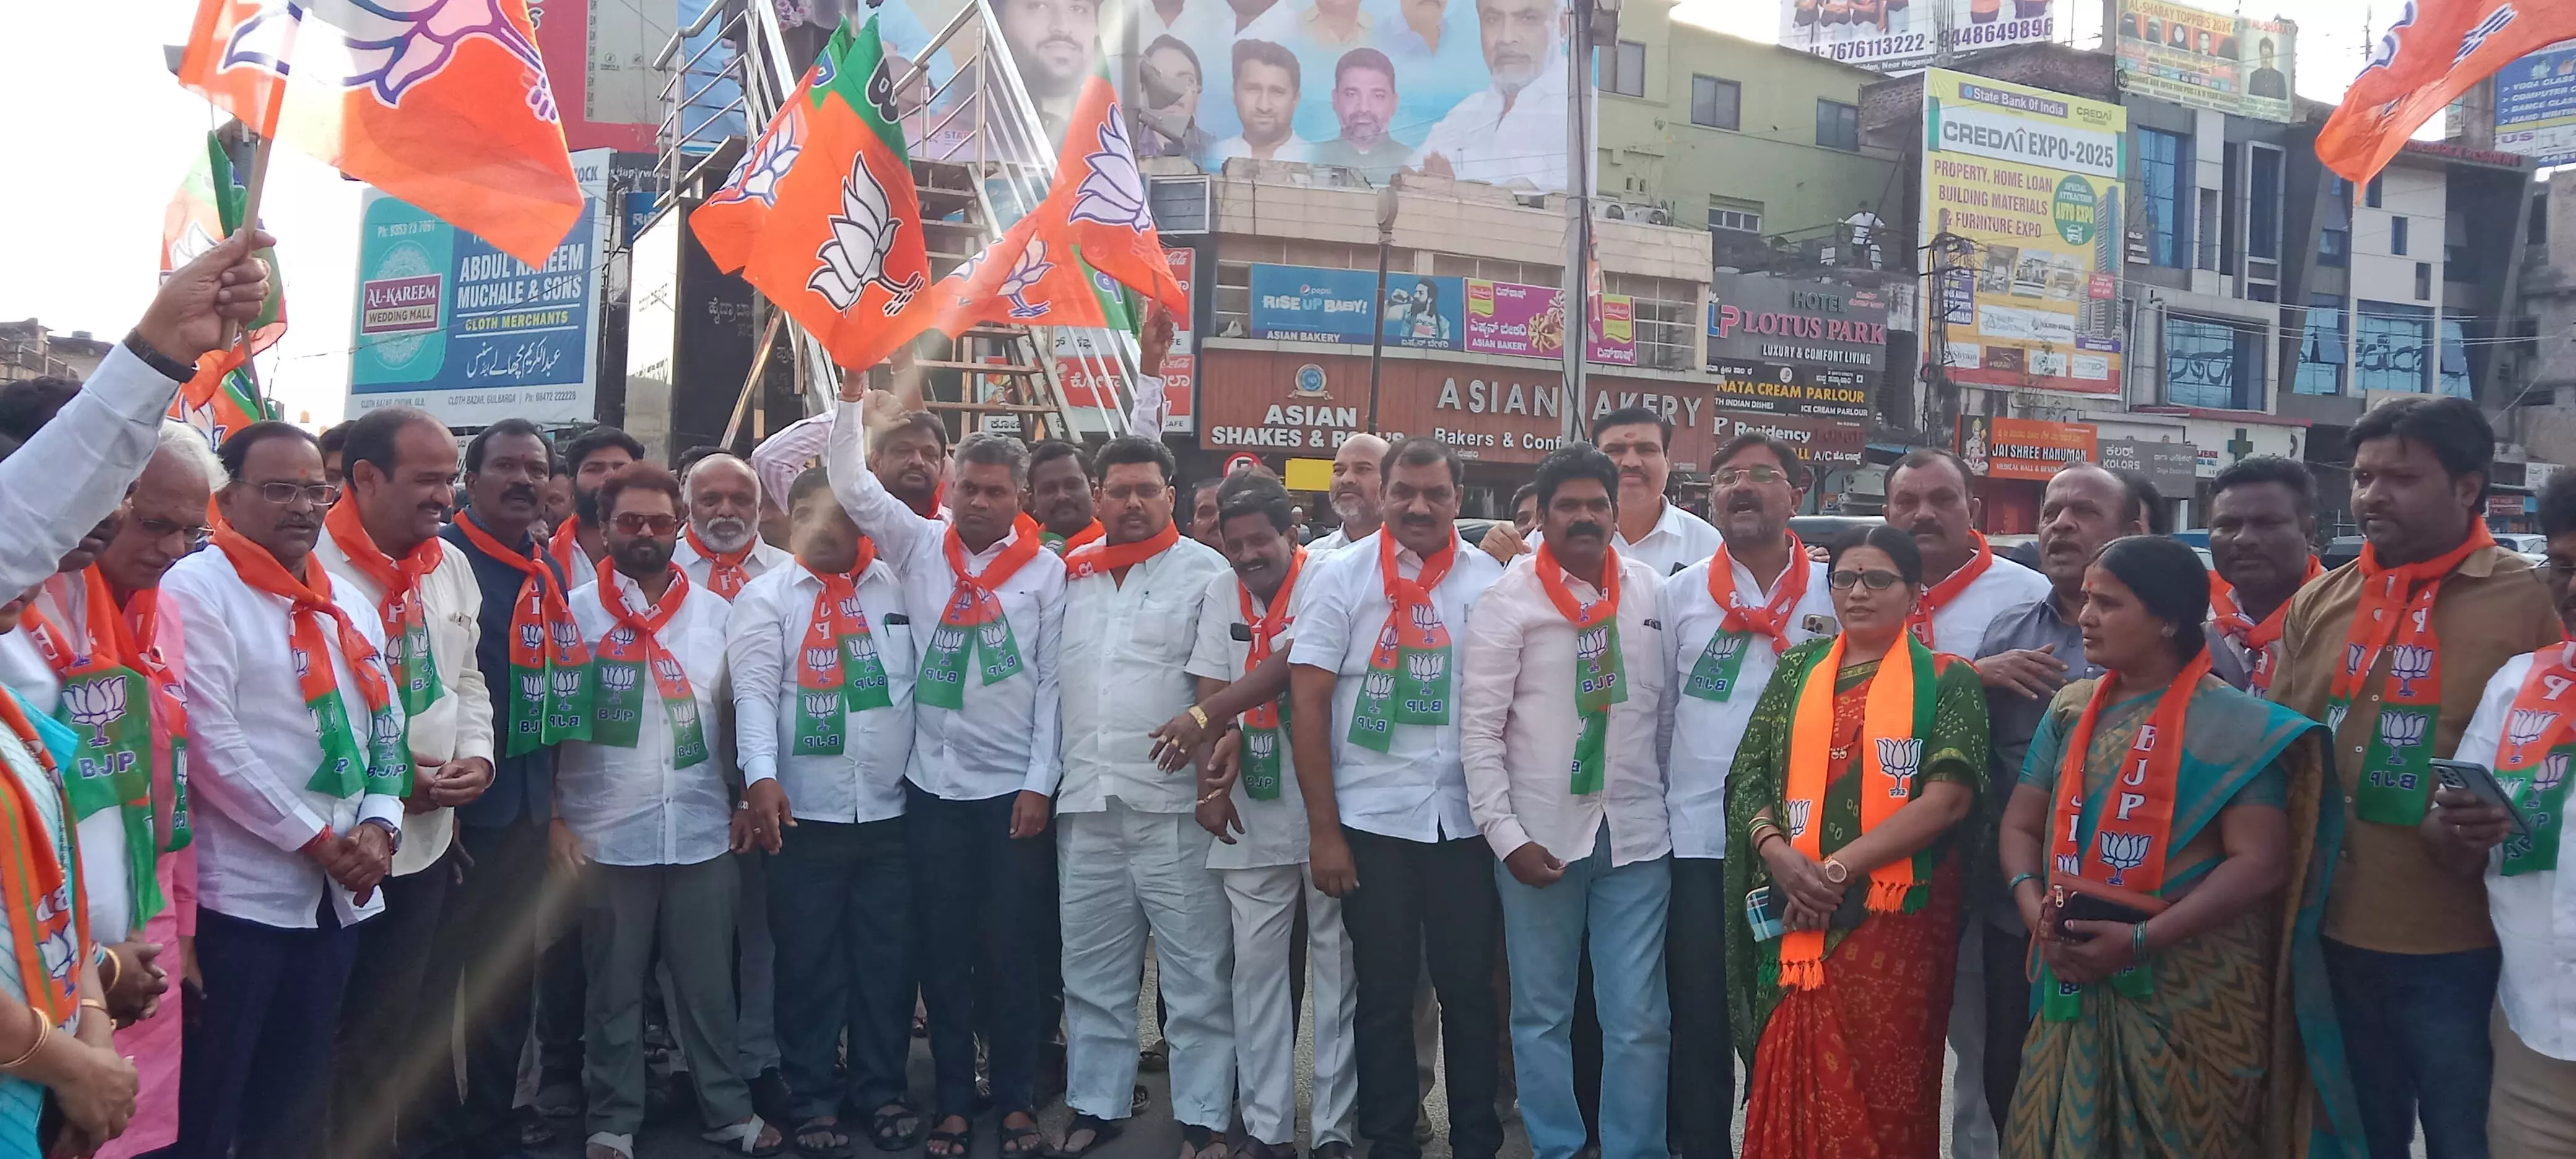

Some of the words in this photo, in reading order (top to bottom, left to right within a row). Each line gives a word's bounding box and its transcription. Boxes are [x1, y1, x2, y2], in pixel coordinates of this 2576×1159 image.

[2128, 2, 2174, 20] AL-SHARAY
[2175, 11, 2212, 28] TOPPERS
[1827, 33, 1925, 60] 7676113222
[1882, 61, 1901, 69] Near
[1901, 56, 1934, 67] Naganah
[1973, 87, 1999, 103] State
[2001, 93, 2027, 110] Bank
[2040, 102, 2064, 116] India
[2511, 87, 2568, 102] COMPUTER
[2029, 132, 2114, 168] EXPO-2025
[1993, 169, 2023, 188] HOME
[2026, 175, 2053, 193] LOAN
[1939, 184, 1988, 206] BUILDING
[1991, 193, 2048, 216] MATERIALS
[1956, 212, 2013, 235] FURNITURE
[2016, 220, 2042, 238] EXPO
[459, 252, 511, 283] ABDUL
[515, 243, 585, 277] KEEM
[367, 284, 436, 308] AL-KAREEM
[457, 280, 524, 309] MUCHALE
[528, 278, 539, 303] &
[542, 274, 583, 302] SONS
[1793, 291, 1847, 312] HOTEL
[369, 310, 408, 323] WEDDING
[409, 307, 432, 321] MALL
[1263, 295, 1301, 311] RISE
[1302, 298, 1323, 311] UP
[1324, 299, 1368, 314] BABY!
[465, 316, 498, 331] CLOTH
[502, 311, 568, 328] MERCHANTS
[1743, 310, 1822, 339] LOTUS
[1826, 318, 1887, 345] PARK
[1267, 330, 1299, 341] ASIAN
[1300, 331, 1341, 343] BAKERY
[1472, 338, 1496, 349] ASIAN
[1497, 340, 1527, 351] BAKERY
[1762, 344, 1795, 358] LUXURY
[1796, 345, 1803, 359] &
[1804, 347, 1843, 363] COMFORT
[1844, 351, 1871, 365] LIVING
[448, 396, 465, 406] CLOTH
[487, 393, 516, 404] GULBARGA
[1437, 377, 1559, 419] ASIAN
[1591, 389, 1703, 427] AKERY
[1757, 383, 1801, 398] CREAM
[1806, 386, 1865, 403] PARLOUR
[1725, 399, 1751, 409] INDIAN
[1751, 400, 1774, 410] DISHES
[1801, 404, 1812, 413] ICE
[1812, 406, 1836, 415] CREAM
[1837, 407, 1868, 417] PARLOUR
[1263, 404, 1357, 428] ASIAN
[1211, 426, 1302, 447] SHAKES
[1308, 428, 1326, 448] &
[1434, 427, 1495, 448] Bakers
[1502, 431, 1515, 448] &
[1522, 433, 1562, 451] Conf
[1813, 450, 1832, 461] A/C
[1991, 442, 2008, 458] JAI
[2009, 445, 2040, 460] SHREE
[2042, 447, 2087, 462] HANUMAN
[2103, 458, 2141, 470] KOLORS
[1581, 672, 1616, 693] BJP
[598, 708, 635, 722] BJP
[520, 719, 542, 733] BJ
[677, 742, 700, 758] BJP
[78, 750, 136, 779] BJP
[367, 764, 407, 778] BJP
